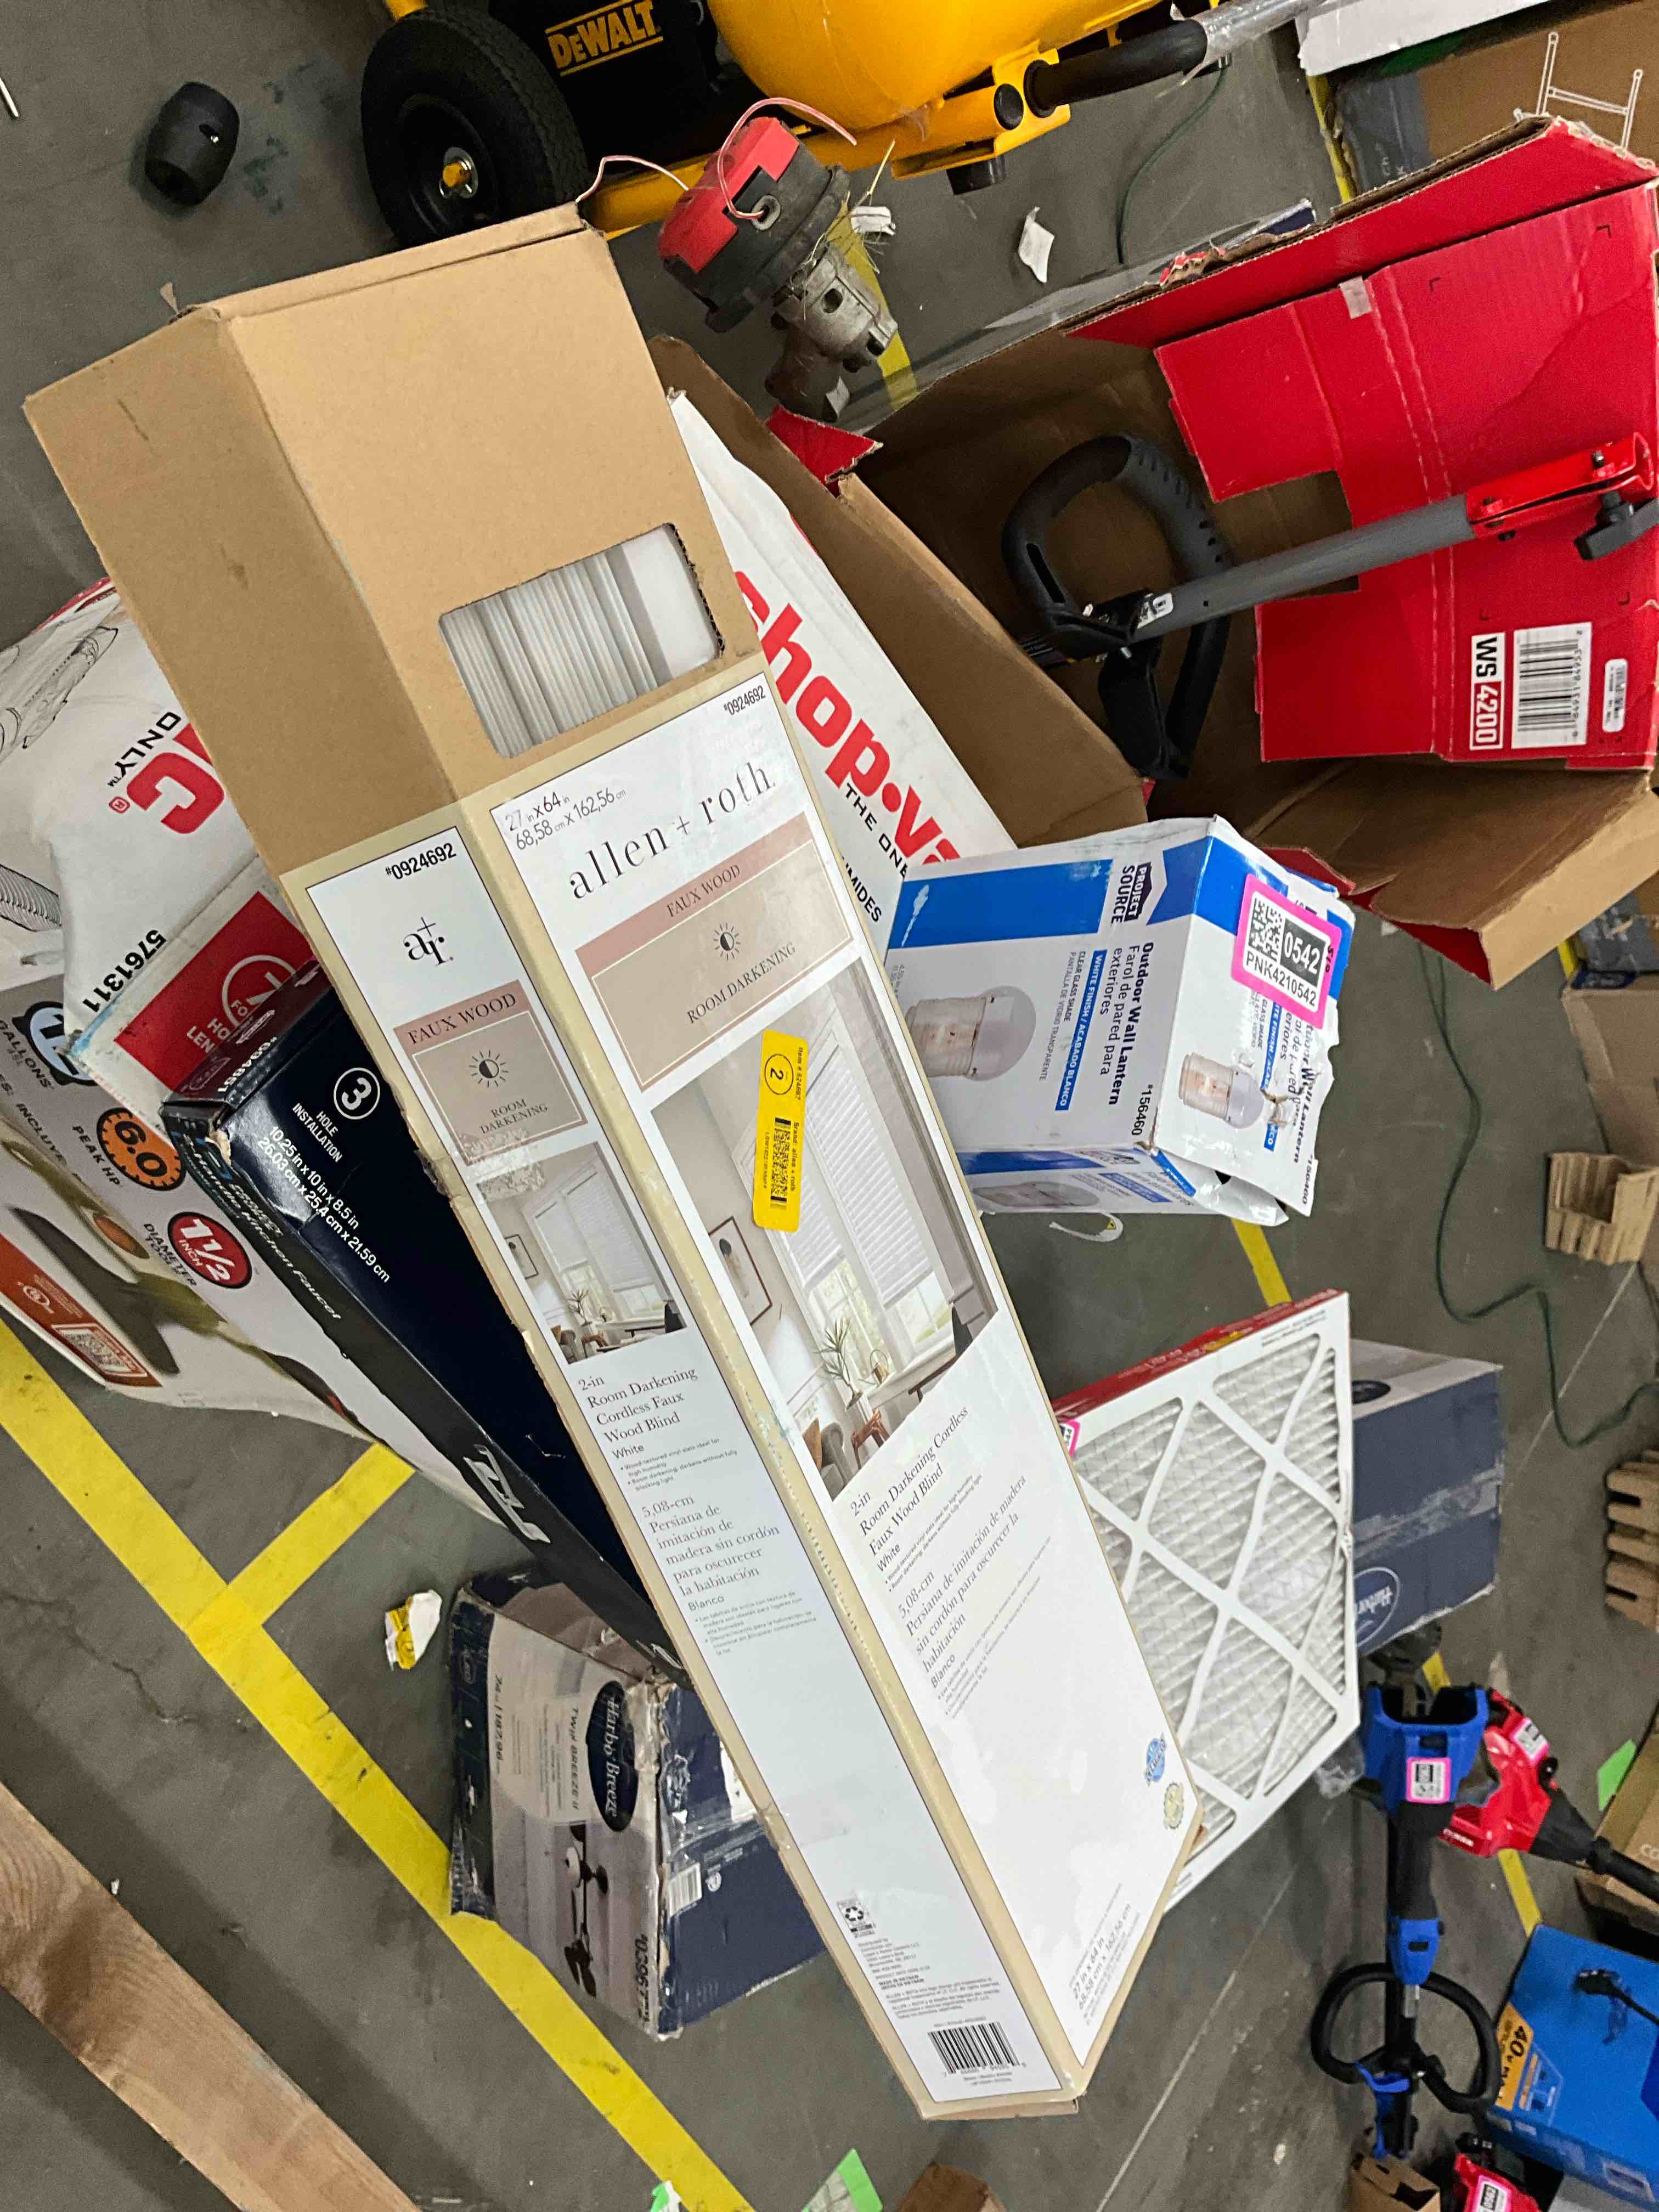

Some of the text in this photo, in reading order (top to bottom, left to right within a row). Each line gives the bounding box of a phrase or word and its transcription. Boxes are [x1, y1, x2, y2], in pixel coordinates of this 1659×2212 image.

[724, 685, 767, 716] #0924692
[1476, 636, 1498, 743] WS 4200
[505, 792, 571, 832] 27 in x 64 in
[515, 787, 627, 851] 68,58 cm x 162,56 cm
[568, 760, 776, 900] allen + roth
[845, 782, 908, 878] THE ONE
[385, 841, 457, 880] #0924692
[666, 864, 741, 918] FAUX WOOD
[843, 856, 882, 922] MIDES
[1110, 865, 1130, 923] SOURCE
[1127, 866, 1147, 919] PROJECT
[83, 929, 167, 1013] 5761311
[1062, 951, 1076, 988] PANTALLA
[1090, 955, 1102, 985] WHITE
[1284, 928, 1321, 974] 0542
[686, 941, 797, 1024] ROOM DARKENING
[1059, 989, 1068, 999] DE
[1063, 951, 1086, 1022] CLEAR GLASS SHADE
[1082, 987, 1094, 1017] FINISH
[1100, 947, 1123, 1016] exteriores
[1246, 953, 1317, 1007] PNK4210542
[407, 991, 518, 1046] FAUX WOOD
[1100, 946, 1140, 1075] Farol de pared para
[1109, 941, 1154, 1105] Outdoor Wall Lantern
[1269, 1017, 1279, 1051] FINISH
[0, 1020, 53, 1088] GALLONS
[187, 1025, 216, 1053] LEN
[1039, 1025, 1059, 1081] TRANSPARENTE
[1069, 1023, 1086, 1068] ACABADO
[1280, 1012, 1293, 1060] eriores
[341, 1077, 372, 1110] 3
[770, 1067, 784, 1080] 2
[1060, 1070, 1074, 1107] BLANCO
[316, 1110, 338, 1137] HOLE
[478, 1103, 549, 1136] DARKENING
[491, 1097, 528, 1119] ROOM
[1131, 1084, 1154, 1136] #156460
[73, 1125, 121, 1186] PEAK HP
[114, 1121, 167, 1177] 6.0
[292, 1103, 343, 1163] INSTALLATION
[1293, 1103, 1313, 1164] Lantern
[270, 1126, 359, 1230] 10.25 in x 10 in x 8.5 in
[258, 1136, 391, 1284] 26.03 cm x 25.4 cm x 21.59 cm
[179, 1239, 203, 1267] INCH
[578, 1376, 605, 1391] 2-in
[587, 1369, 698, 1409] Room Darkening
[597, 1392, 685, 1426] Cordless Faux
[603, 1411, 681, 1444] Wood Blind
[611, 1444, 645, 1460] White
[859, 1406, 969, 1537] Room Darkening Cordless
[641, 1495, 695, 1518] 5,08-cm
[648, 1505, 721, 1534] Persiana de
[850, 1490, 871, 1517] 2-in
[868, 1462, 944, 1557] Faux Wood Blind
[657, 1518, 734, 1550] imitación de
[665, 1525, 780, 1565] madera sin cordón
[877, 1542, 901, 1573] White
[906, 1474, 1028, 1638] Persiana de imitación de madera
[673, 1547, 763, 1584] para oscurecer
[679, 1566, 760, 1597] la habitación
[915, 1511, 1020, 1656] sin cordón para oscurecer la
[688, 1595, 725, 1612] Blanco
[898, 1571, 935, 1620] 5,08-cm
[922, 1612, 967, 1674] habitación
[930, 1653, 956, 1690] Blanco
[603, 1696, 620, 1818] Harbo Breeze
